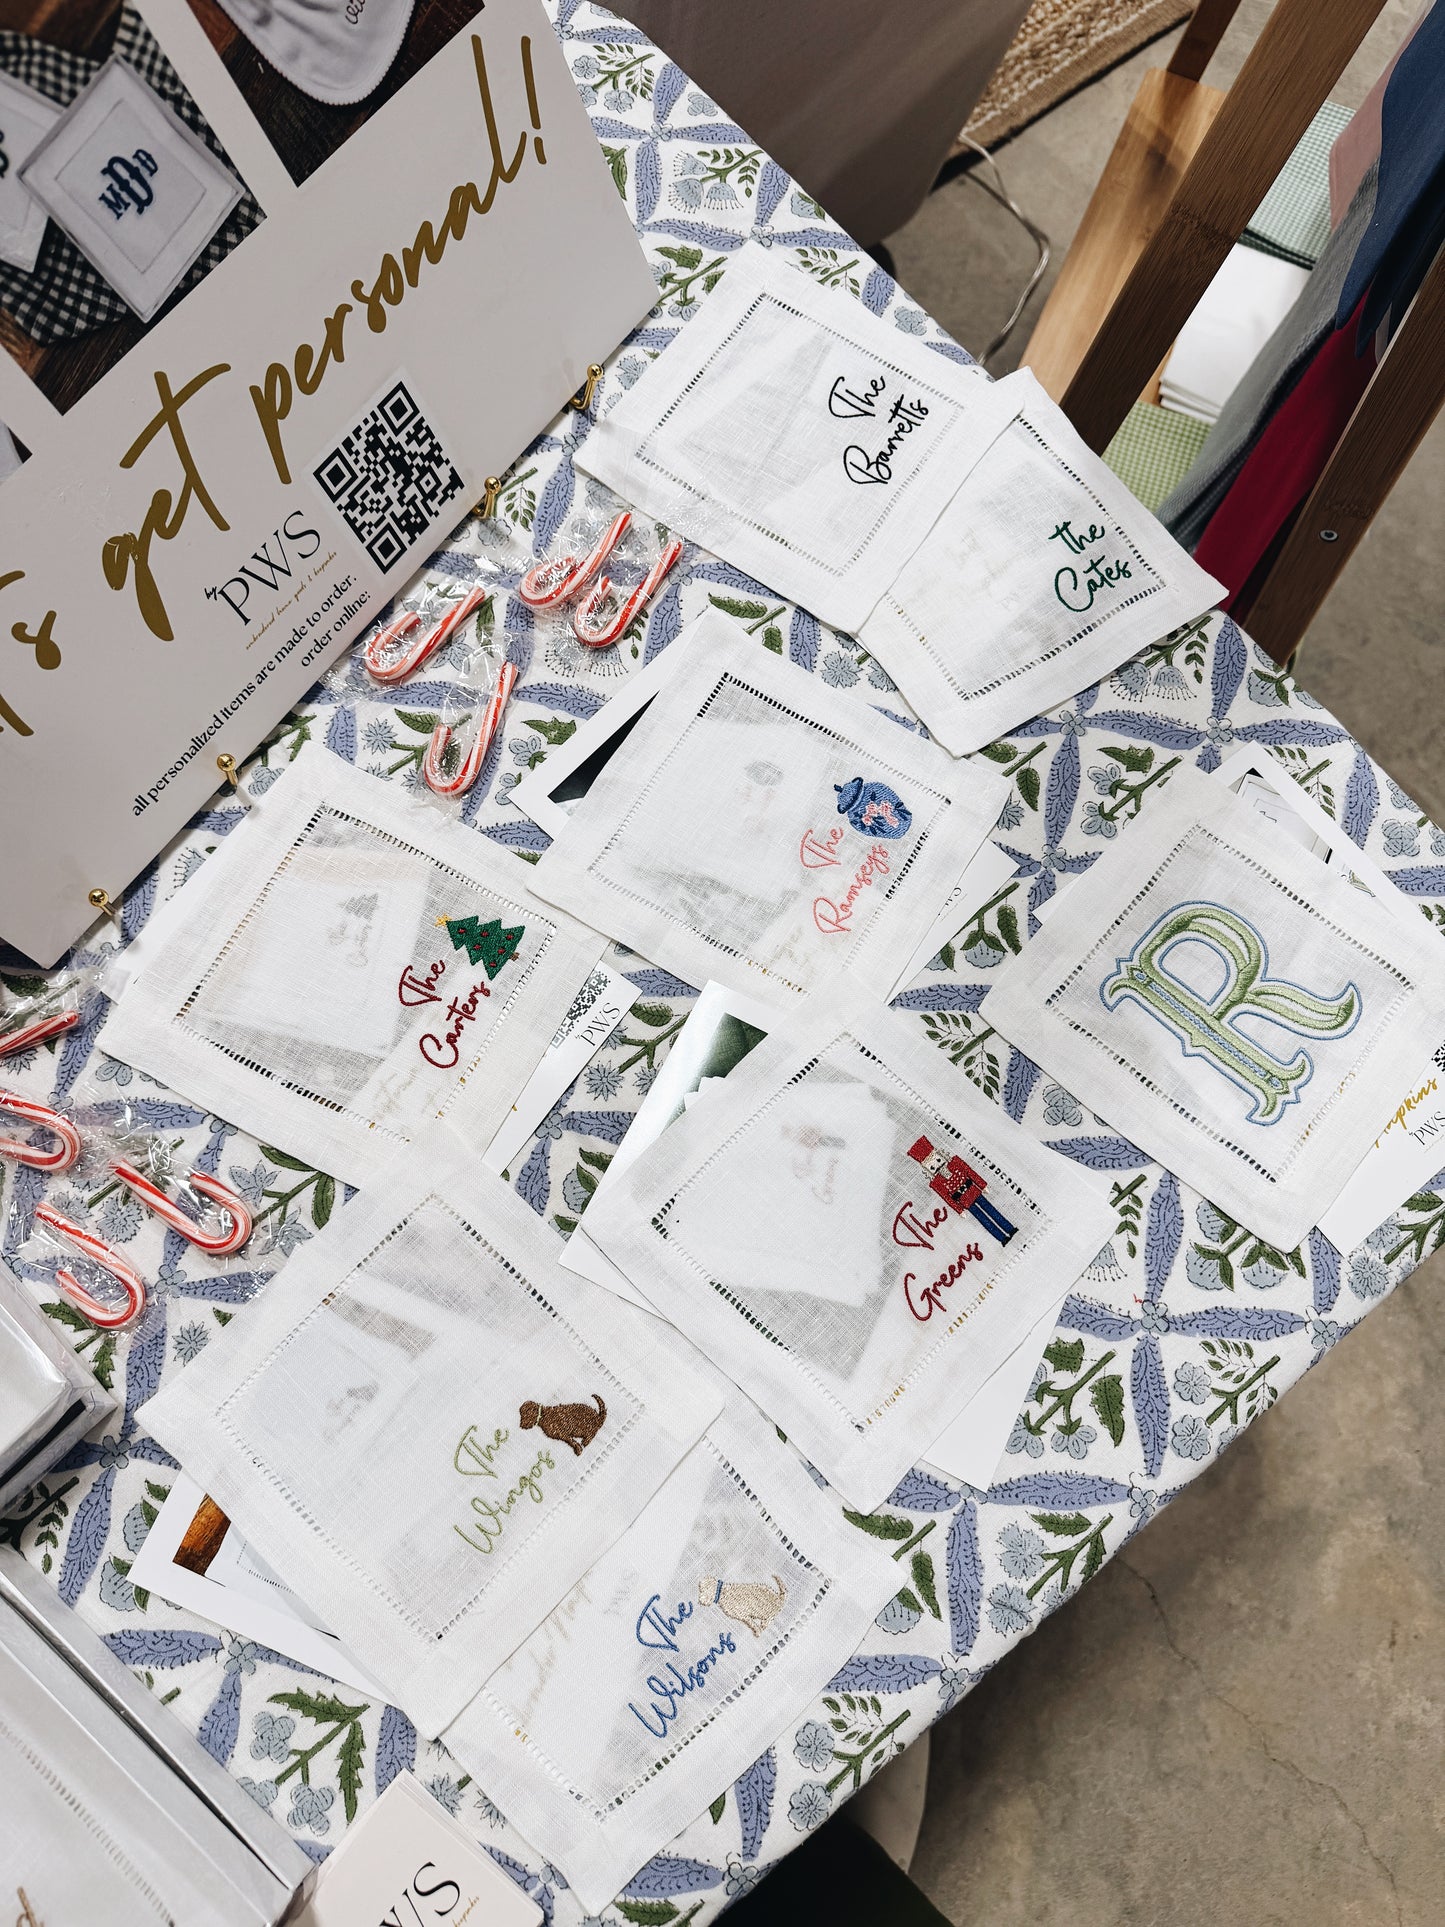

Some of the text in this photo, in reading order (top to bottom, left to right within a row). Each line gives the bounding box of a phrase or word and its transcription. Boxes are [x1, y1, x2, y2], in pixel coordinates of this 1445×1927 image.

[102, 34, 547, 641] get personal!
[828, 376, 886, 418] The
[843, 394, 929, 484] Barretts
[217, 510, 321, 626] PWS
[1048, 521, 1105, 554] the
[204, 586, 218, 601] by
[1054, 555, 1132, 612] Cates
[301, 591, 371, 667] order online:
[132, 574, 357, 816] all personalized items are made to order.
[800, 827, 844, 868] The
[813, 843, 890, 933] Ramseys
[398, 960, 446, 1006] The
[419, 981, 491, 1069] Carters
[579, 1002, 621, 1047] PWS
[1375, 1078, 1438, 1149] apkins
[893, 1201, 949, 1250] The
[904, 1243, 984, 1321] Greens
[454, 1425, 509, 1479] The
[453, 1450, 555, 1554] Wingos
[636, 1594, 694, 1652] The
[628, 1632, 737, 1738] Wilsons
